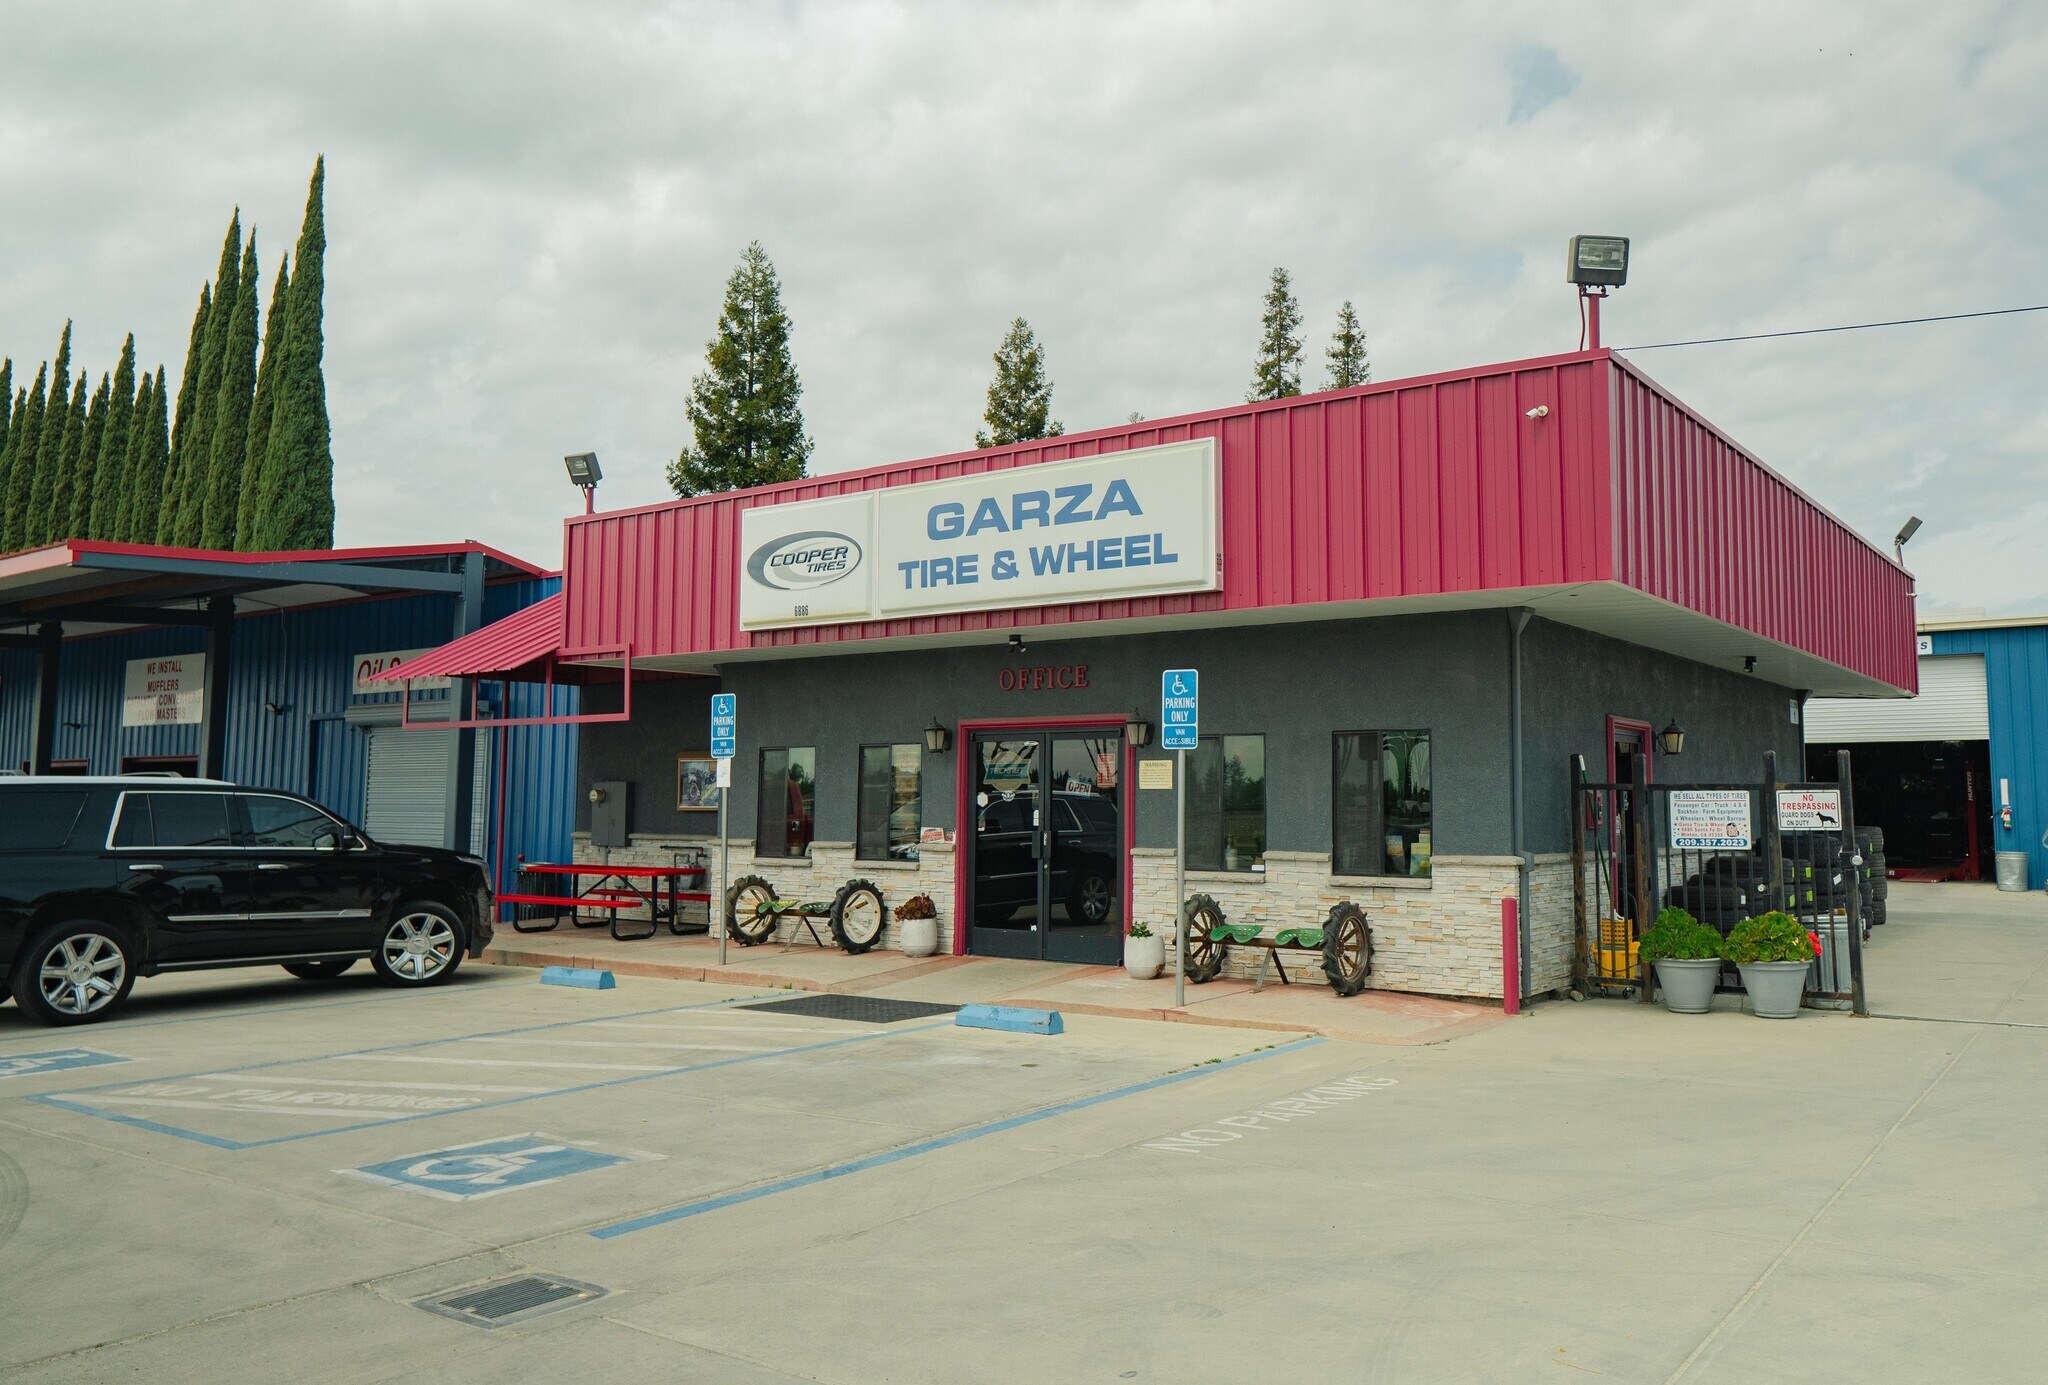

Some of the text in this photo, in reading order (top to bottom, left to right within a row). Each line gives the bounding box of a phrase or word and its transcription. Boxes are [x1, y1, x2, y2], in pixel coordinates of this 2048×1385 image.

[927, 479, 1143, 540] GARZA
[770, 546, 848, 567] COOPER
[898, 554, 978, 589] TIRE
[991, 550, 1019, 580] &
[1029, 533, 1178, 576] WHEEL
[807, 560, 846, 573] TIRES
[794, 605, 808, 616] 6886
[147, 660, 182, 674] WE INSTALL
[999, 665, 1089, 691] OFFICE
[147, 680, 179, 692] MUFFLERS
[1165, 697, 1195, 708] PARKING
[713, 716, 733, 725] PARKING
[1171, 711, 1189, 722] ONLY
[717, 727, 730, 736] ONLY
[1068, 781, 1090, 793] OPEN
[1133, 1075, 1399, 1153] NO PARKING
